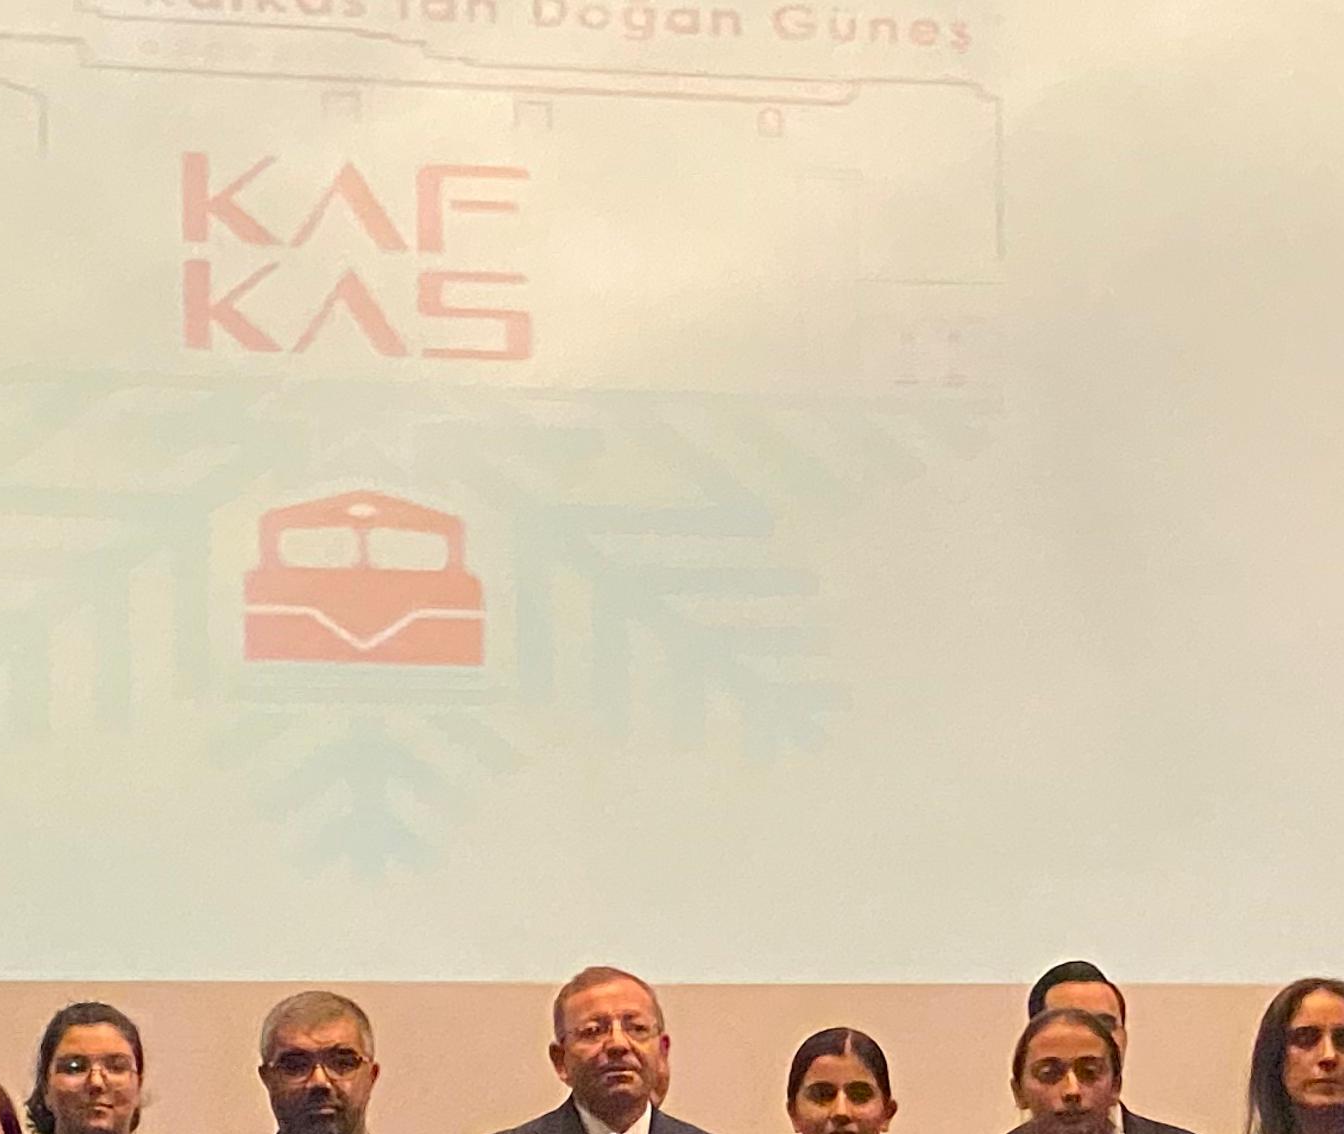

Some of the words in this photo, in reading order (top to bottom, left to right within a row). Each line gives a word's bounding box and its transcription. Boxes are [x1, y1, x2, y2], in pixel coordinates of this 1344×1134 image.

[771, 4, 972, 53] Güneş
[182, 151, 530, 254] KAF
[182, 258, 533, 360] KAS
